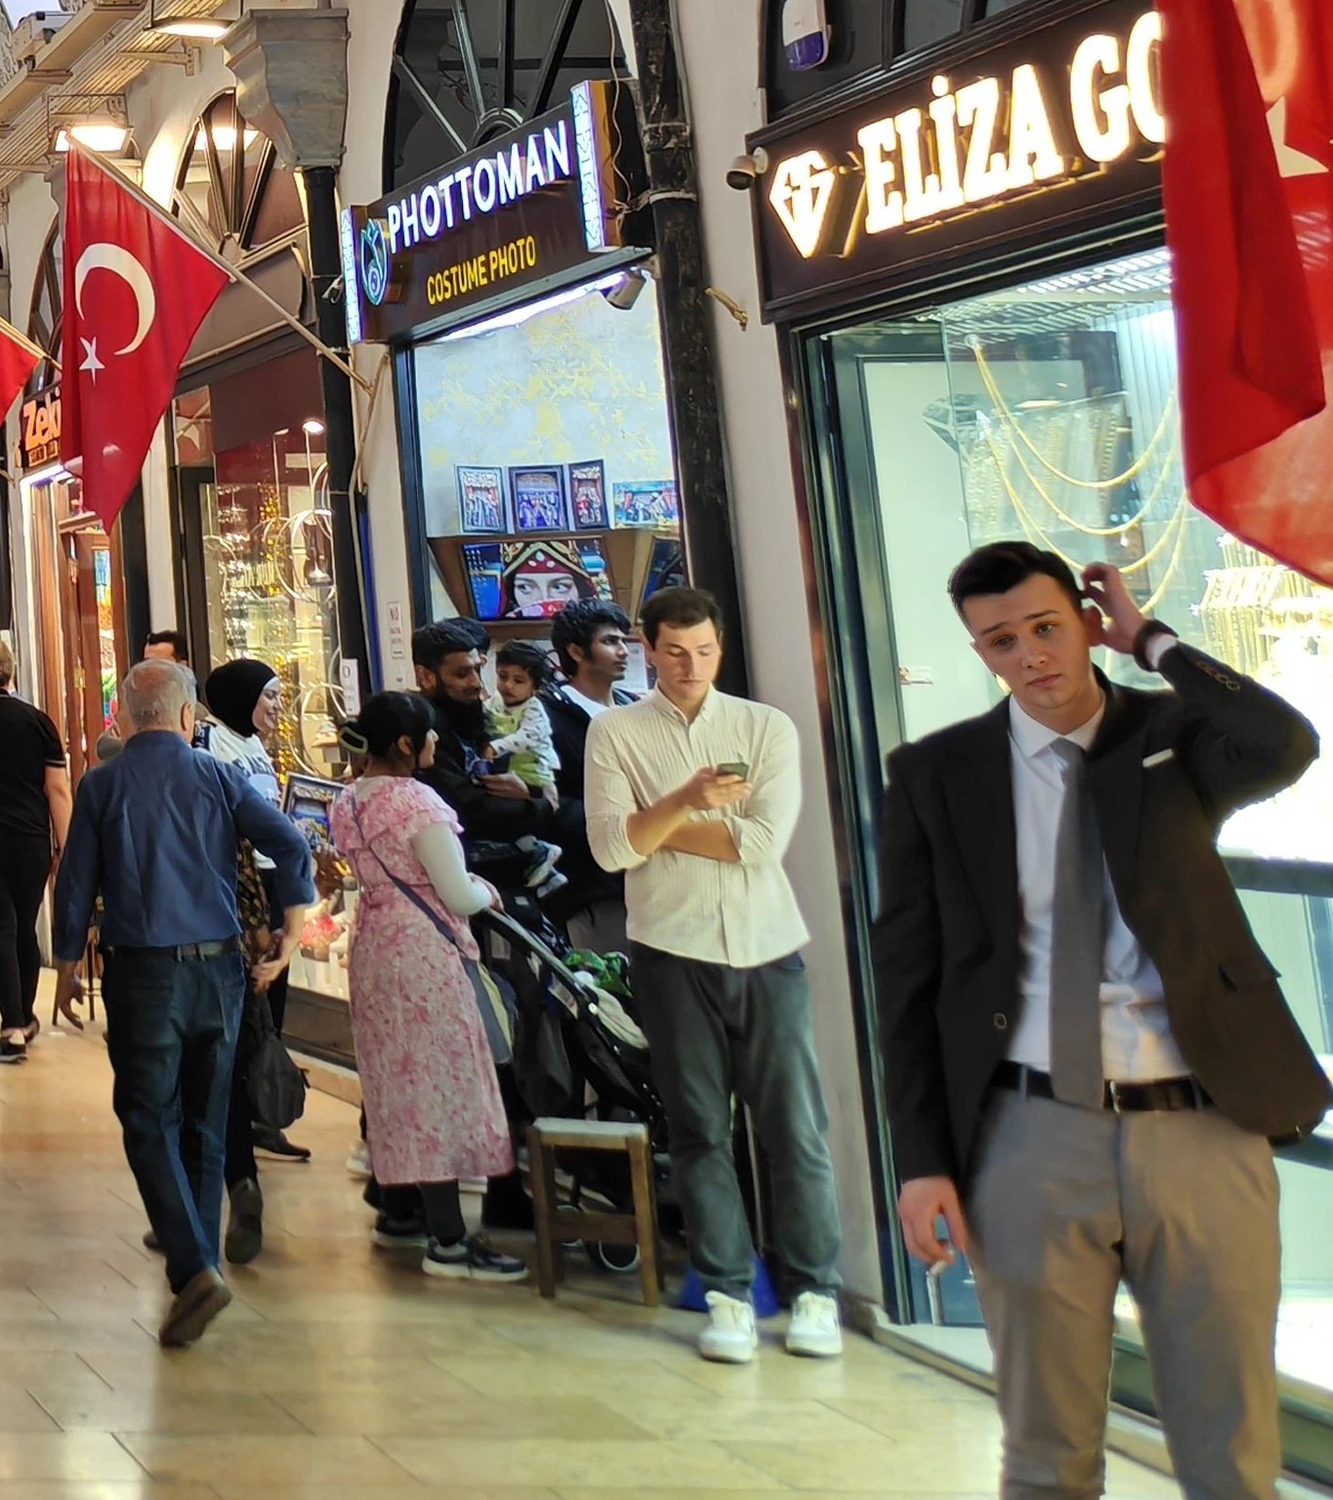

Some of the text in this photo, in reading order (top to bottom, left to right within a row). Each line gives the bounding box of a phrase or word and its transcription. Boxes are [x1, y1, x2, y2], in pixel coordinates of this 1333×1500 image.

[387, 119, 571, 255] PHOTTOMAN
[857, 11, 1167, 235] ELİZA GO
[426, 235, 537, 306] COSTUME PHOTO
